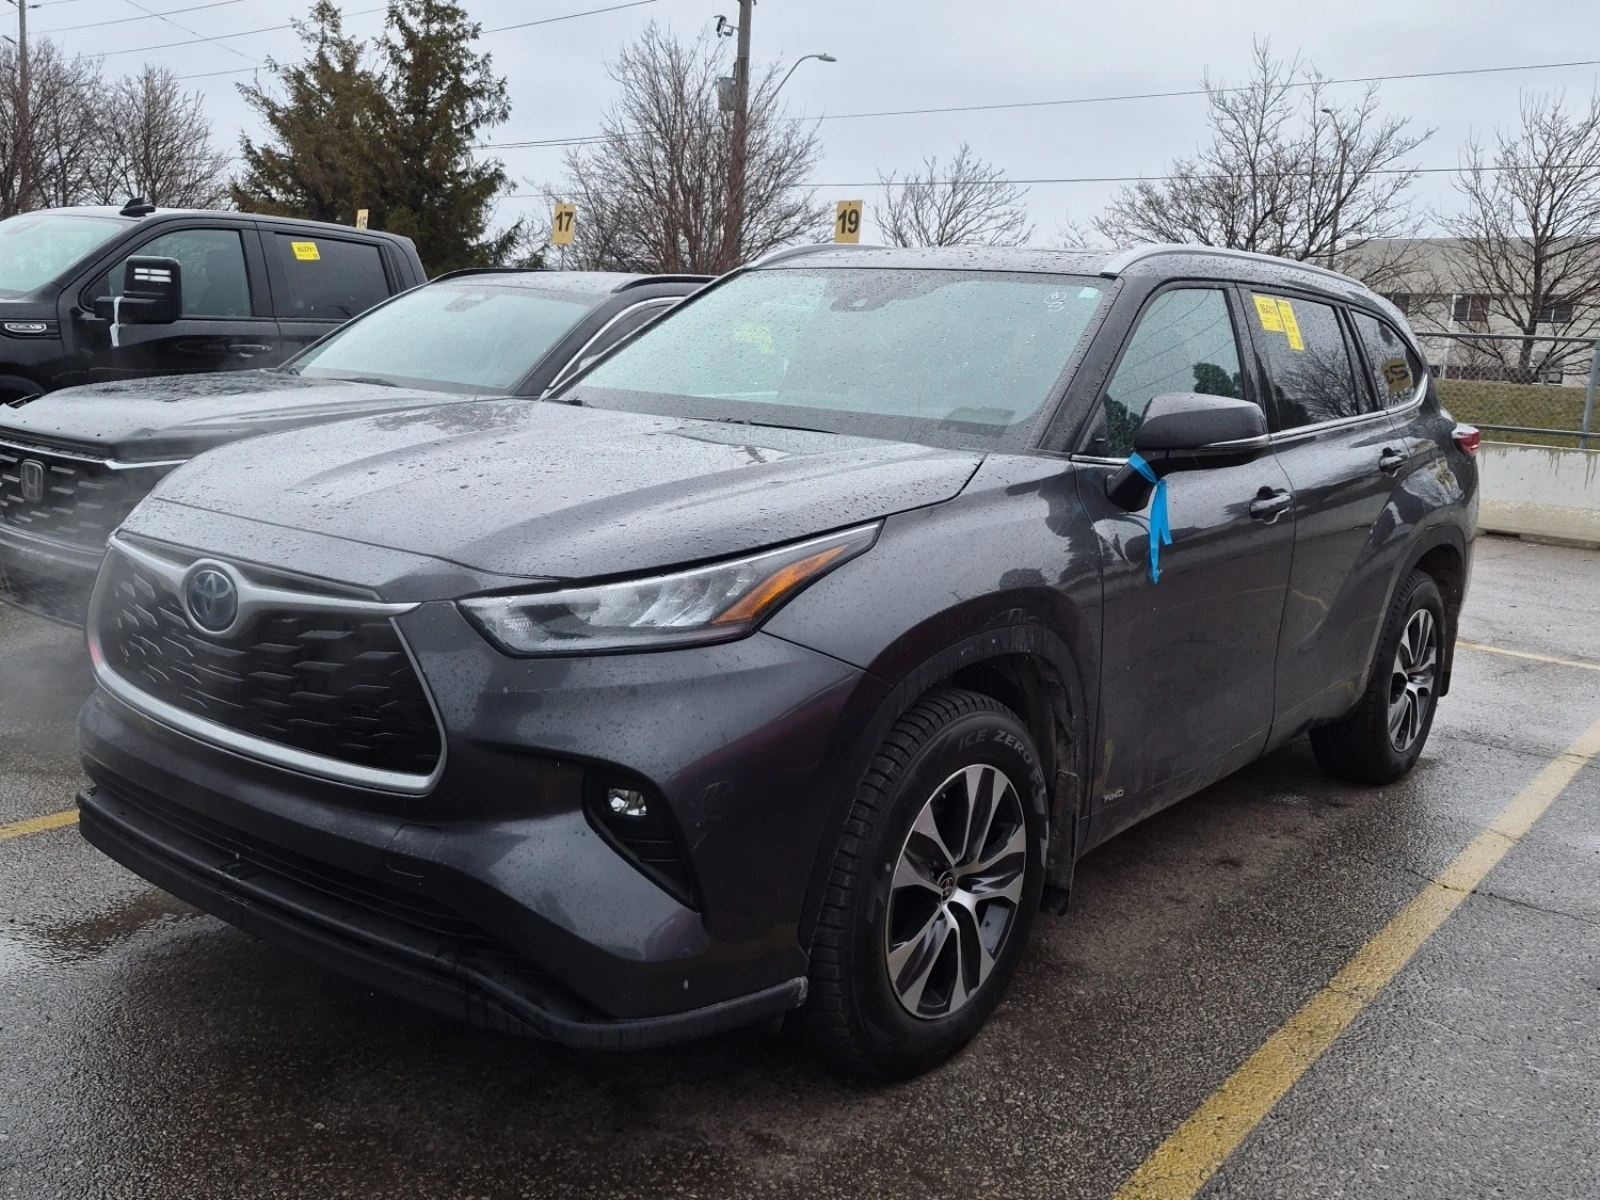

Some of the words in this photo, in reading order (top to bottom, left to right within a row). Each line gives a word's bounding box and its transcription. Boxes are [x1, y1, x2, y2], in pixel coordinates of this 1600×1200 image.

[556, 211, 574, 232] 17
[838, 209, 860, 234] 19
[957, 727, 988, 752] ICE
[992, 730, 1032, 764] ZERO
